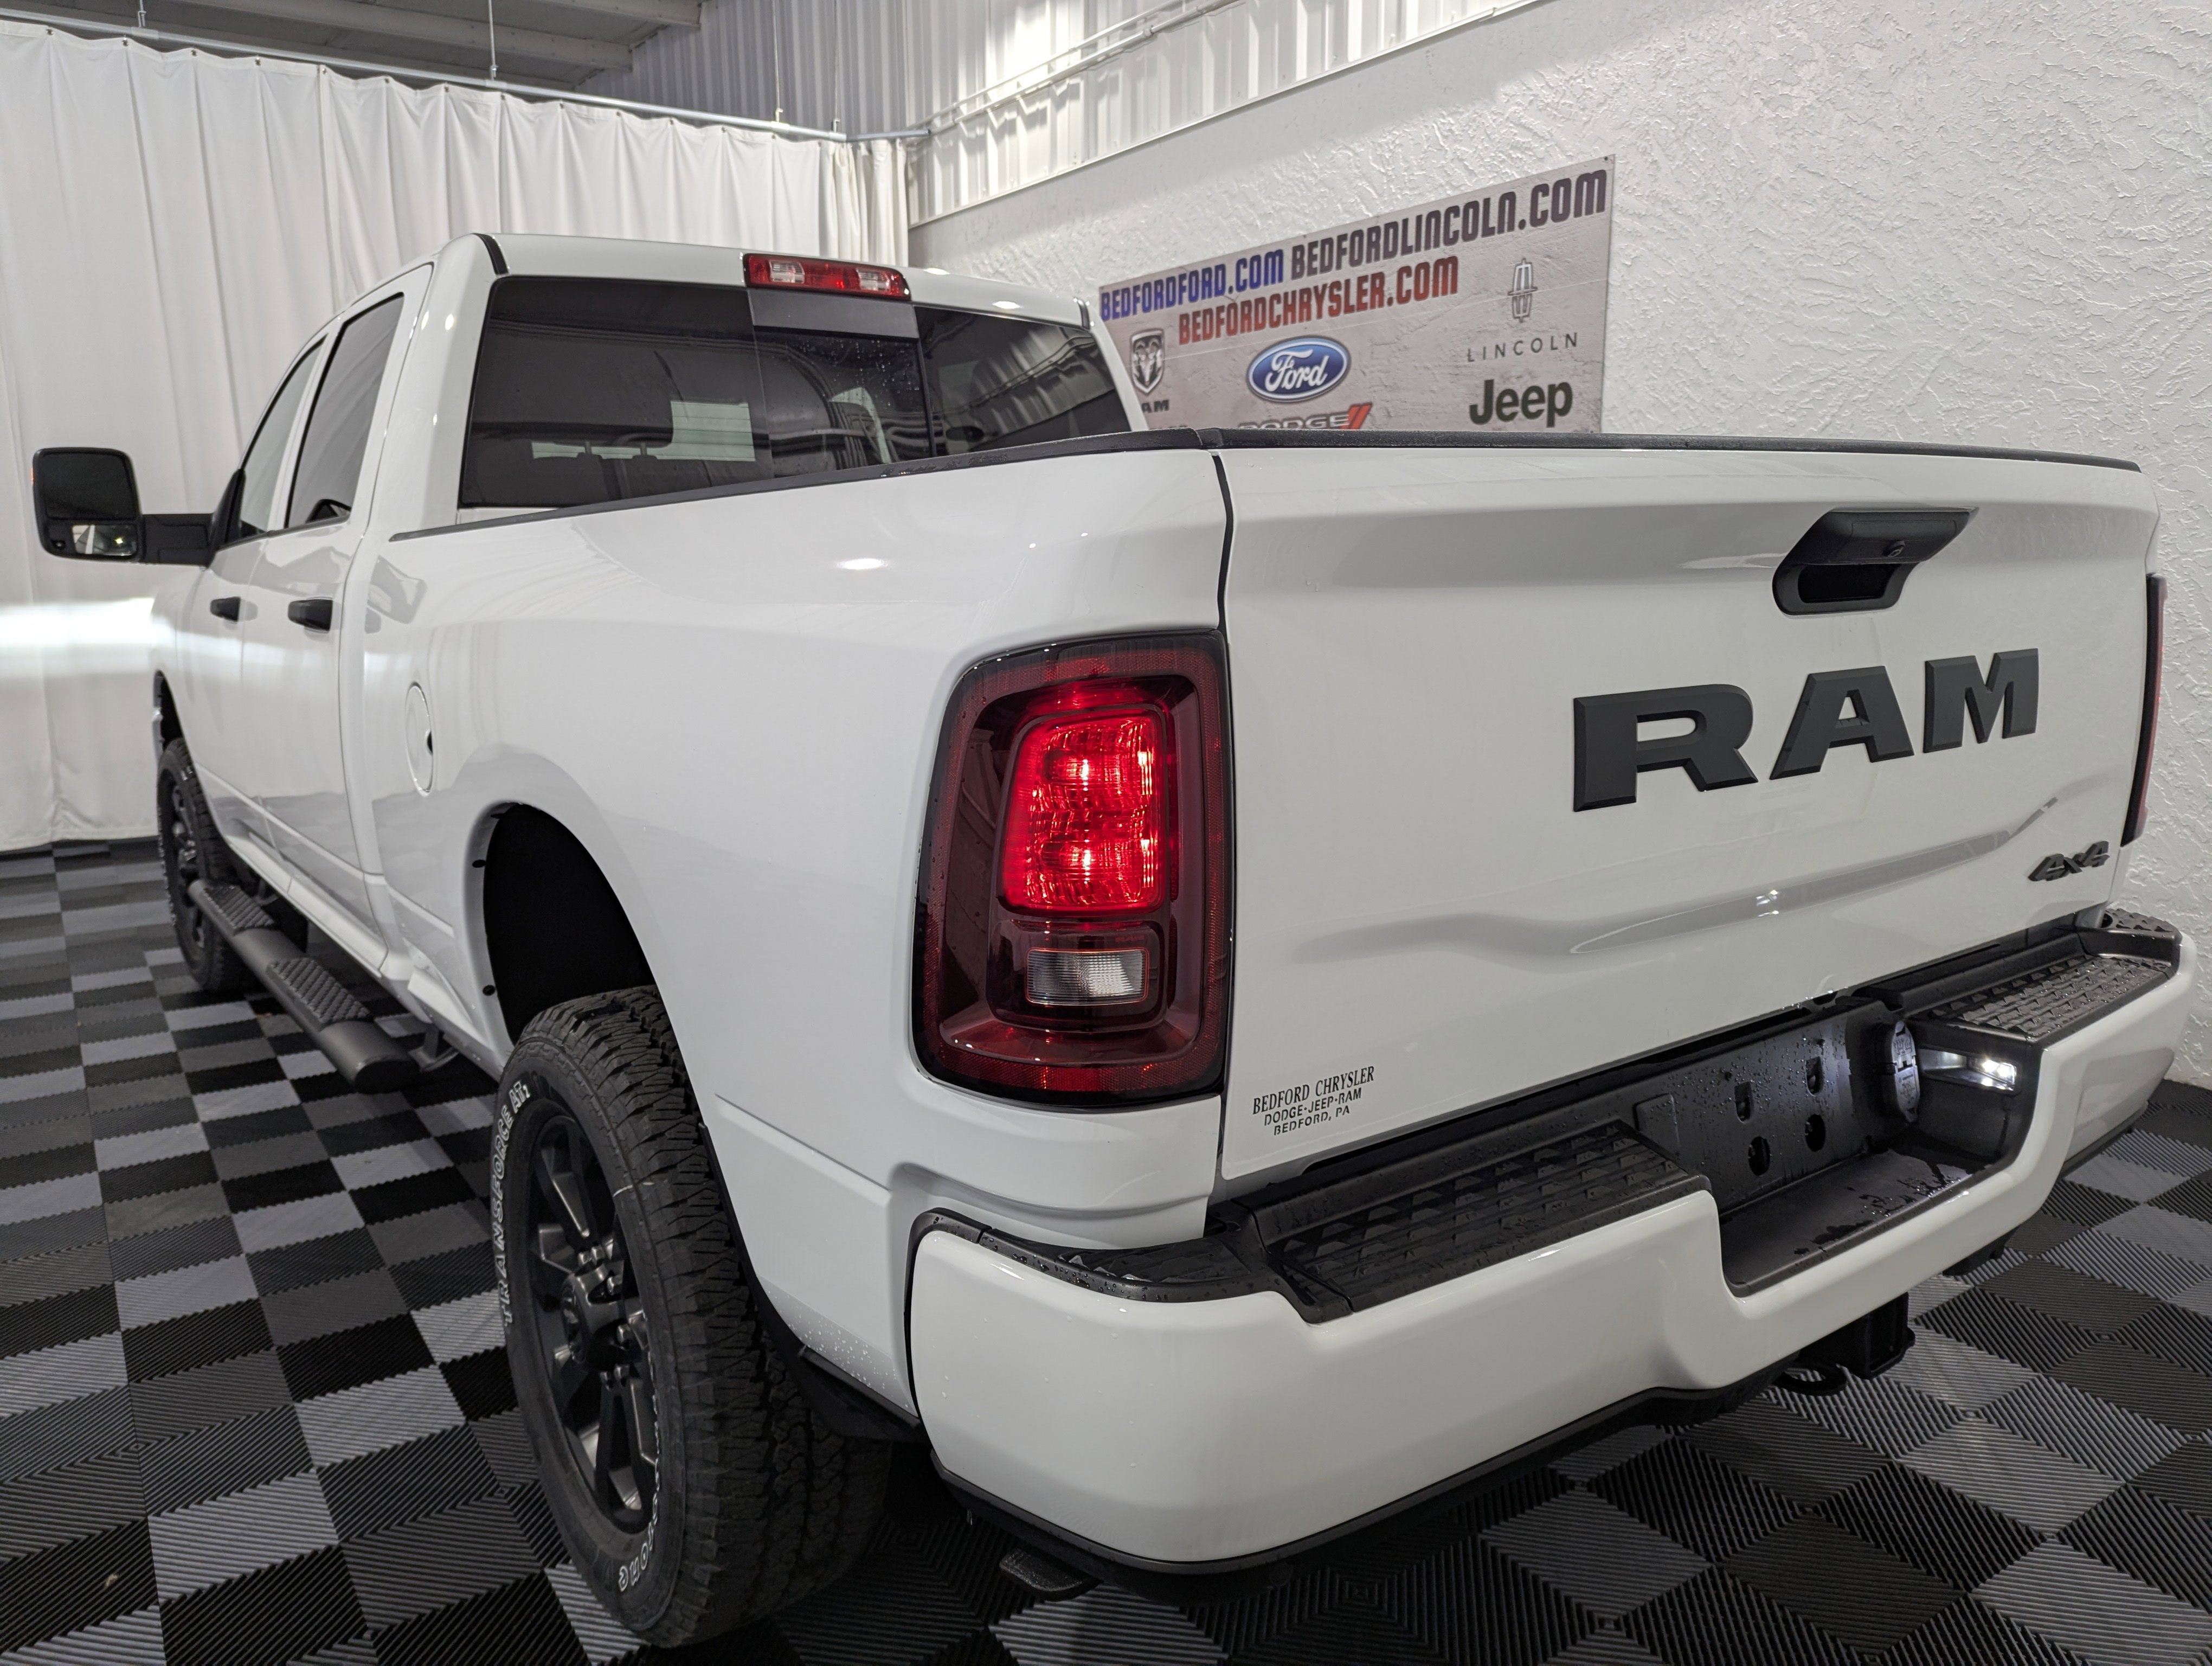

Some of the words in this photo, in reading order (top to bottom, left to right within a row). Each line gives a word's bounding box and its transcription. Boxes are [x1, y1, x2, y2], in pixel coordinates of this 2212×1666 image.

[1101, 249, 1284, 322] BEDFORDFORD.COM
[1291, 169, 1607, 280] BEDFORDLINCOLN.COM
[1179, 255, 1459, 345] BEDFORDCHRYSLER.COM
[1264, 348, 1330, 392] Ford
[1467, 332, 1578, 363] LINCOLN
[1141, 399, 1170, 414] AM
[1469, 379, 1573, 428] Jeep
[1573, 648, 2039, 812] RAM
[1252, 1084, 1310, 1115] BEDFORD
[1315, 1066, 1375, 1097] CHRYSLER
[1274, 1111, 1332, 1136] BEDFORD,
[1335, 1105, 1351, 1118] PA
